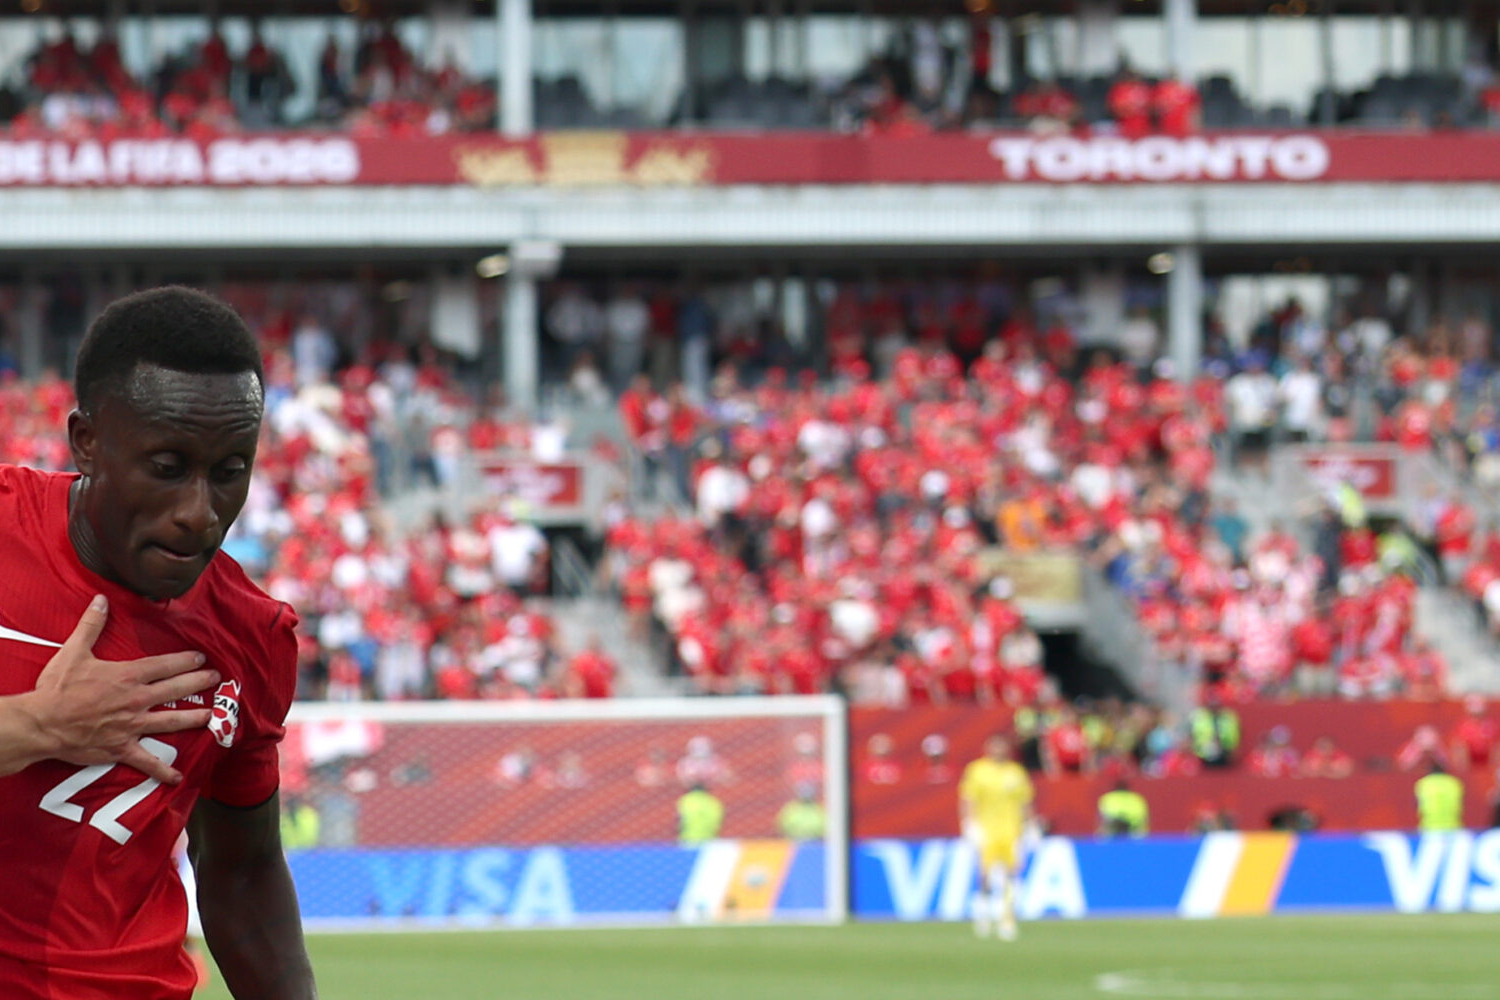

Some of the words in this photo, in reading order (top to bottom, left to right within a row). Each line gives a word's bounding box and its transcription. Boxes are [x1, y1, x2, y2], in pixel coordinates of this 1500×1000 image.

[49, 139, 106, 182] LA
[109, 139, 204, 182] FIFA
[208, 138, 360, 182] 2026
[989, 135, 1329, 180] TORONTO
[367, 846, 576, 925] VISA
[864, 836, 1088, 920] VIA
